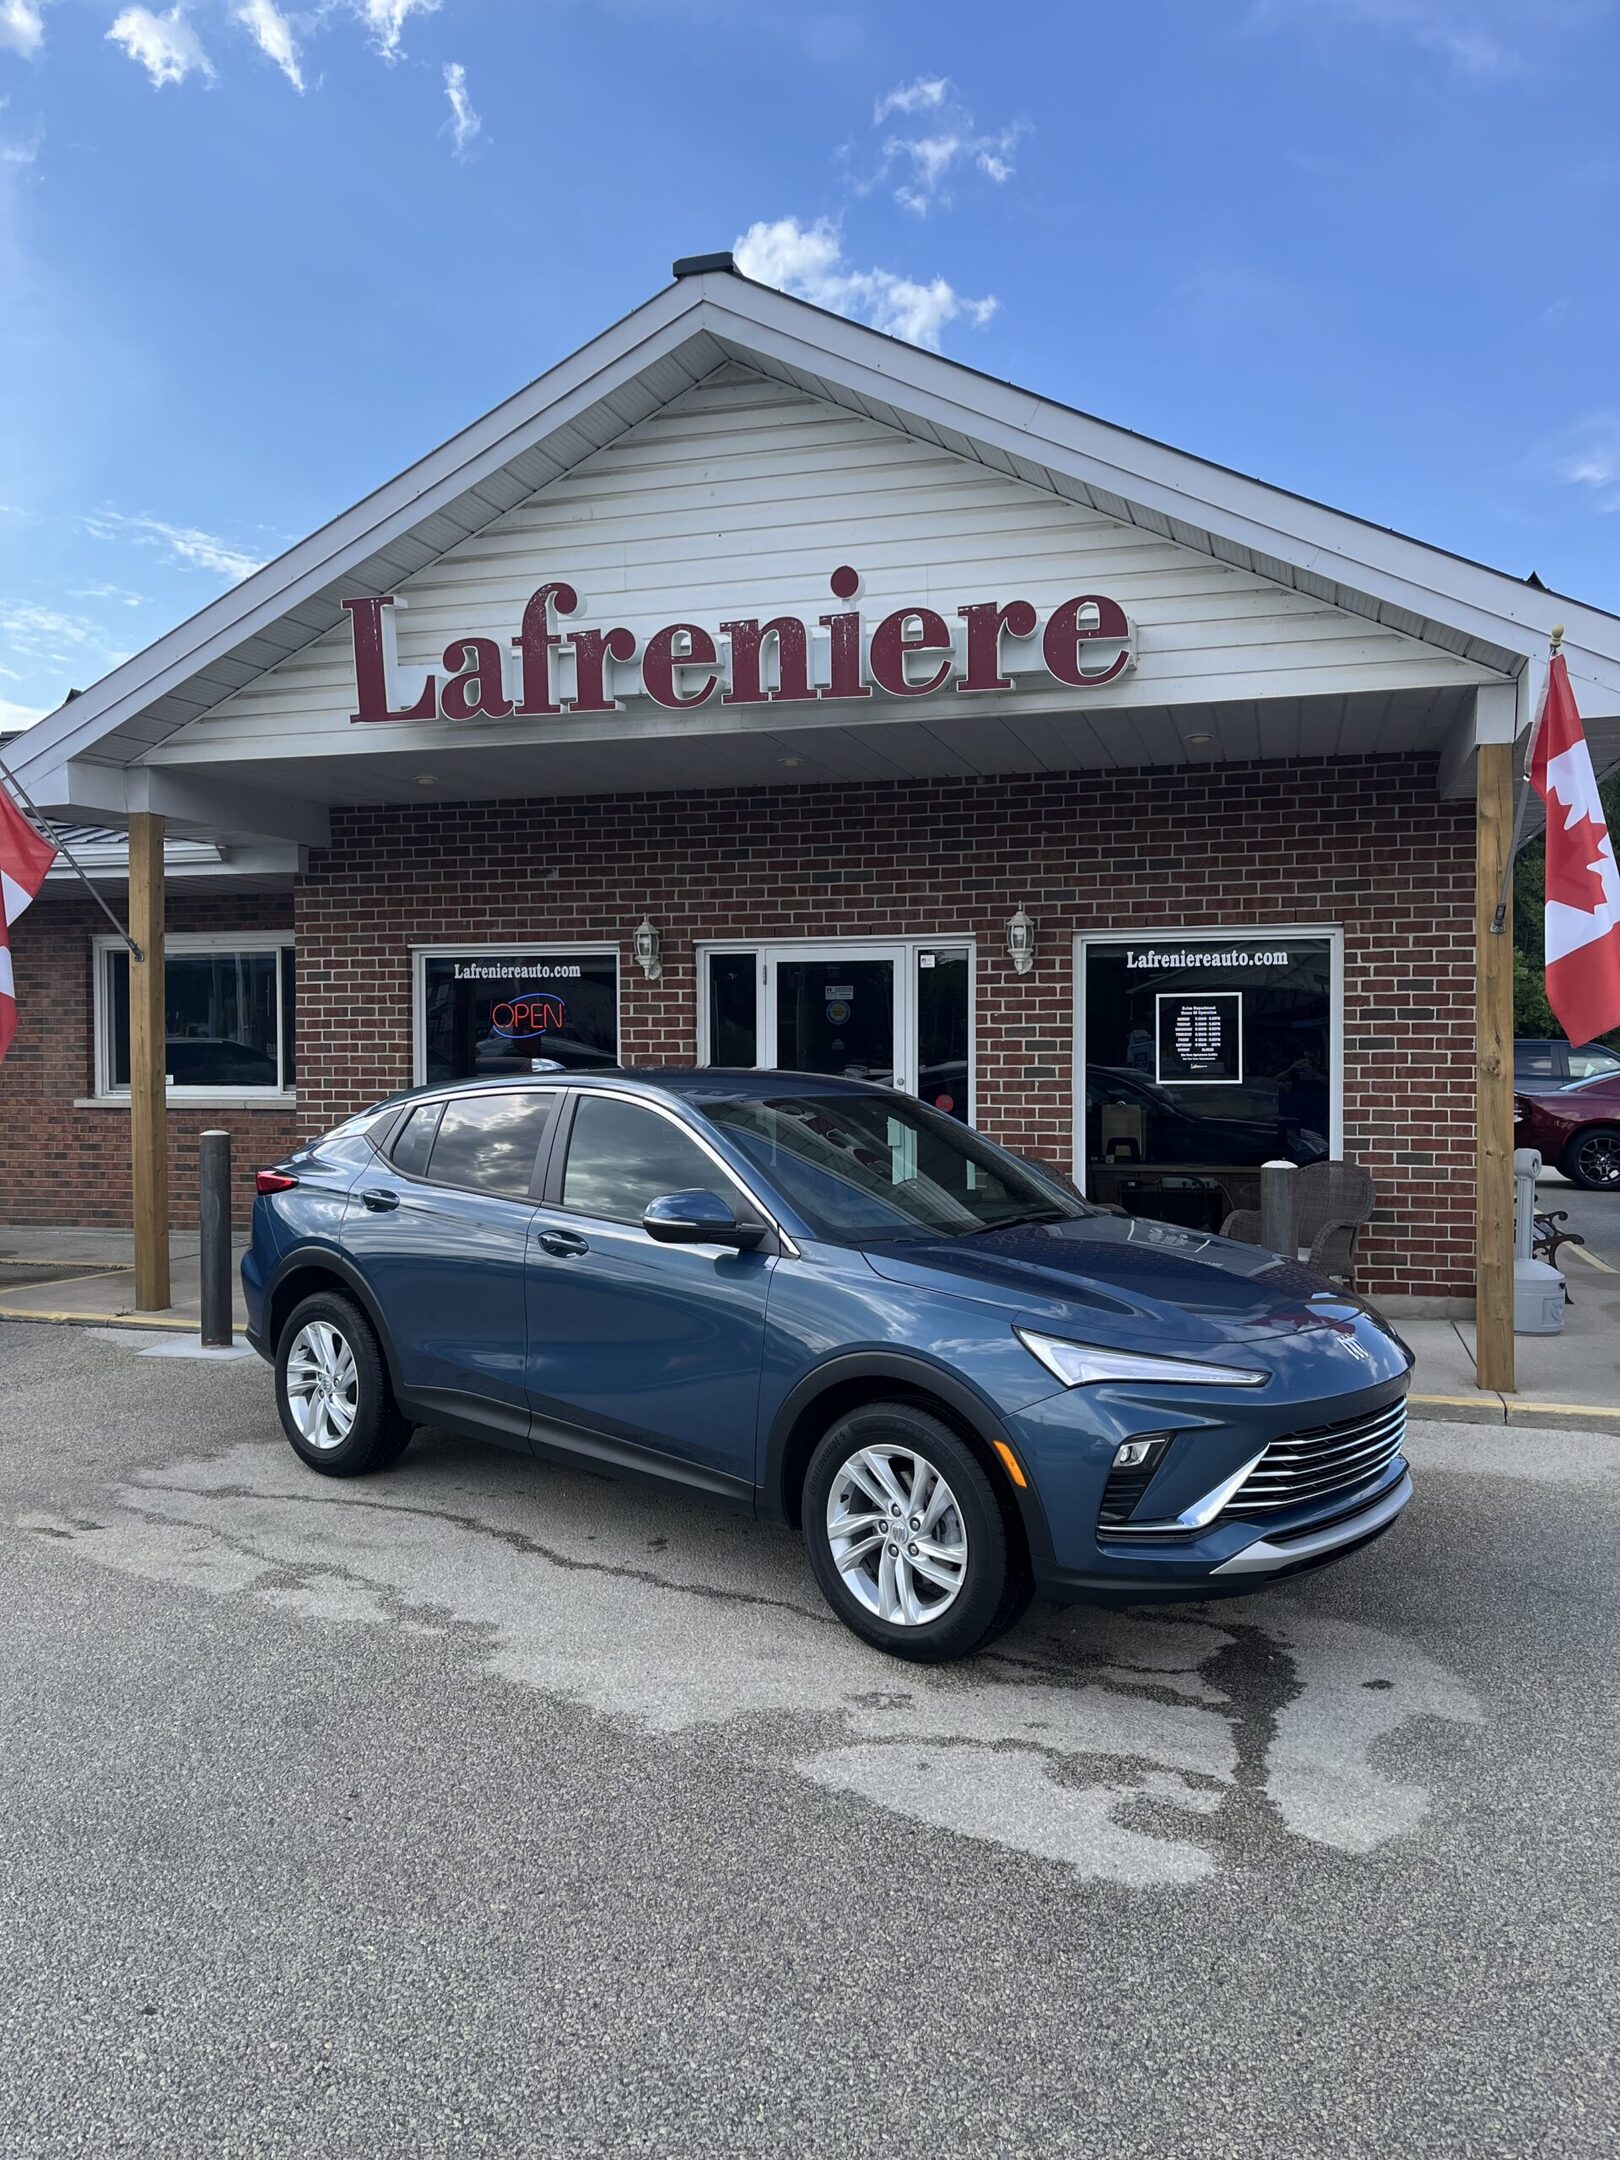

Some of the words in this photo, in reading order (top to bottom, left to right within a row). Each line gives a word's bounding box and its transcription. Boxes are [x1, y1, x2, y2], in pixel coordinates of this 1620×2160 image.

[341, 566, 1132, 723] Lafreniere
[1126, 950, 1288, 968] Lafreniereauto.com
[454, 963, 581, 979] Lafreniereauto.com
[492, 1003, 562, 1028] OPEN
